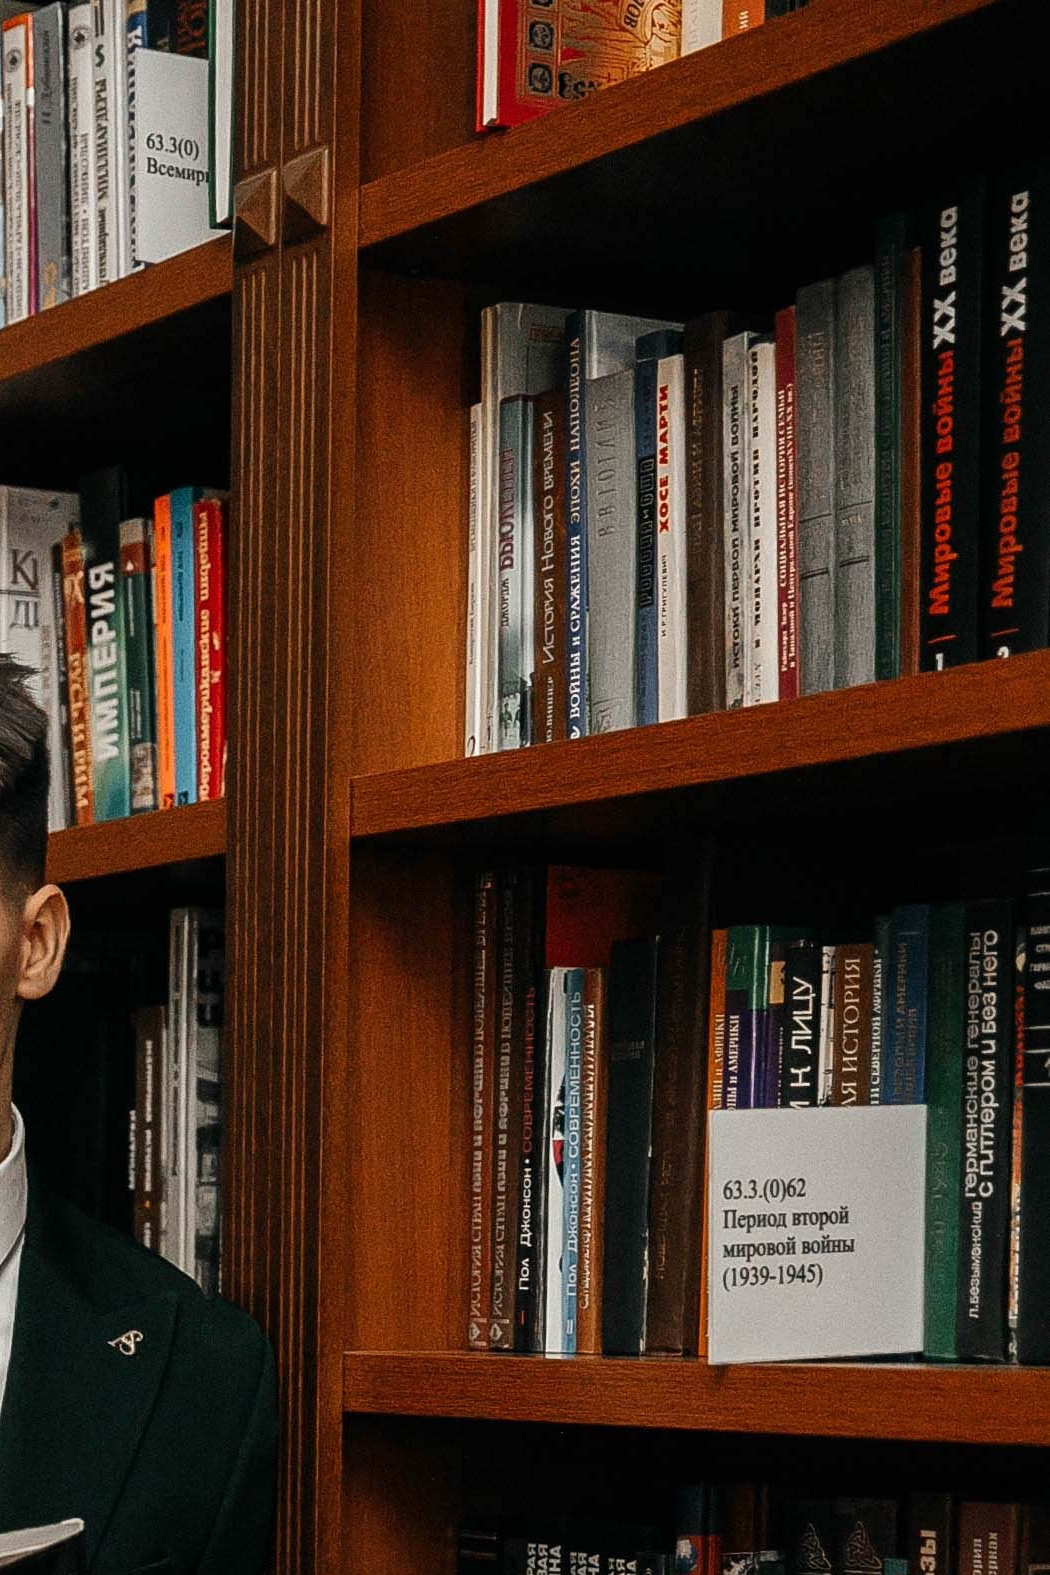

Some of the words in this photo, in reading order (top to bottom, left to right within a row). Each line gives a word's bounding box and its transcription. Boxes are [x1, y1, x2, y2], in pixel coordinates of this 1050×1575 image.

[146, 132, 200, 161] 63.3(0)
[938, 206, 959, 284] века
[1005, 190, 1031, 272] века
[658, 383, 669, 465] МАРТИ
[931, 351, 957, 454] войны
[992, 337, 1025, 446] войны
[569, 460, 582, 524] ЭПОХИ
[659, 474, 670, 534] ХОСЕ
[730, 450, 741, 533] МИРОВОЙ
[990, 450, 1025, 608] Мировые
[928, 461, 958, 616] Мировые
[568, 534, 583, 631] СРАЖЕНИЯ
[88, 561, 119, 761] ИМПЕРИЯ
[731, 607, 741, 669] ИСТОКИ
[567, 652, 583, 719] ВОЙНЫ
[728, 1014, 740, 1074] АМЕРИКИ
[790, 975, 816, 1055] ЛИЦУ
[841, 957, 861, 1073] ИСТОРИЯ
[870, 1016, 882, 1085] СЕВЕРНОЙ
[566, 991, 582, 1159] СОВРЕМЕННОСТЬ
[518, 1167, 532, 1248] Джонсон
[565, 1173, 579, 1253] Джонсон
[723, 1177, 807, 1203] 63.3.(0)62
[723, 1209, 788, 1233] Период
[792, 1206, 850, 1231] второй
[518, 1258, 530, 1292] Пол
[566, 1263, 577, 1297] Пол
[722, 1263, 824, 1292] (1939-1945)
[723, 1237, 797, 1262] мировой
[801, 1235, 855, 1255] войны
